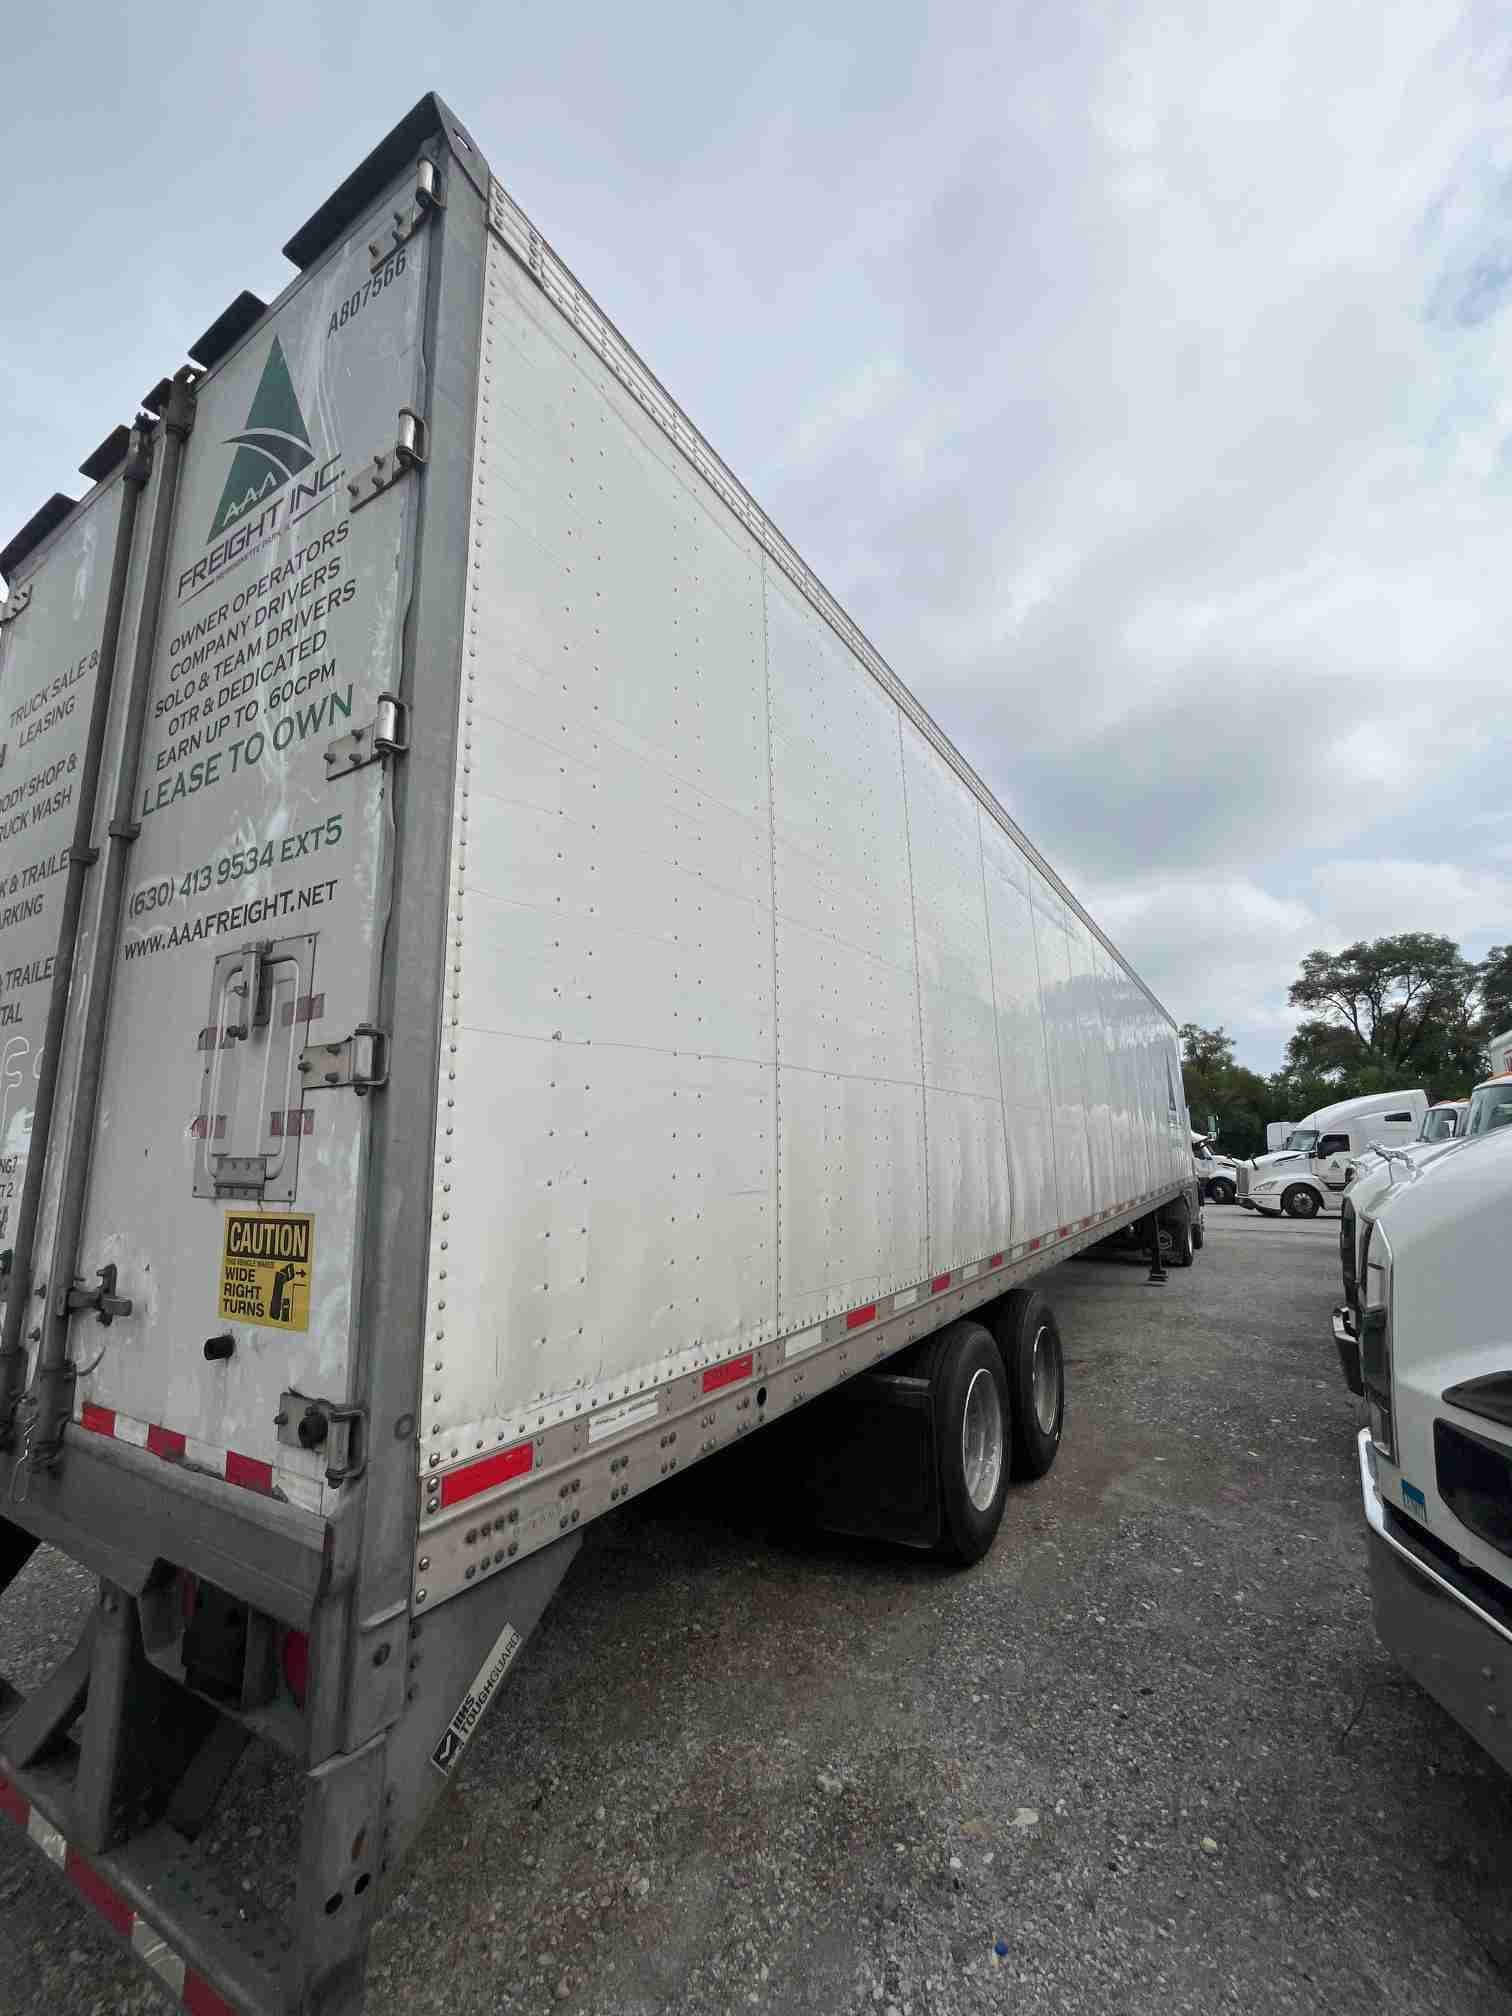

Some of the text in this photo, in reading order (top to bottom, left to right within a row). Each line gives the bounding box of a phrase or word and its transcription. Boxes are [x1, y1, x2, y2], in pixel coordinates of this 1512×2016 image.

[327, 249, 406, 339] A807566
[178, 498, 285, 598] FREIGHT
[289, 453, 346, 514] INC.
[170, 604, 229, 656] OWNER
[233, 520, 349, 613] OPERATORS
[170, 616, 250, 682] COMPANY
[254, 556, 341, 628] DRIVERS
[155, 579, 356, 719] SOLO & TEAM DRIVERS
[10, 649, 98, 729] TRUCK SALE &
[168, 630, 327, 736] OTR & DEDICATED
[19, 695, 75, 748] LEASING
[142, 683, 353, 817] LEASE TO OWN
[156, 731, 202, 771] EARN
[206, 715, 230, 743] UP
[234, 700, 259, 728] TO
[0, 783, 26, 812] ODY
[28, 760, 66, 797] SHOP
[32, 785, 72, 825] WASH
[22, 849, 71, 889] TRAILE
[128, 877, 175, 919] (630)
[179, 866, 212, 897] 413
[216, 840, 274, 884] 9534
[0, 894, 44, 929] RKING
[6, 957, 56, 992] TRAILE
[0, 1001, 23, 1025] TAL
[230, 1221, 307, 1257] CAUTION
[223, 1282, 262, 1300] RIGHT
[224, 1266, 256, 1283] WIDE
[223, 1298, 265, 1318] TURNS
[460, 1633, 521, 1734] TOUGHGUARD
